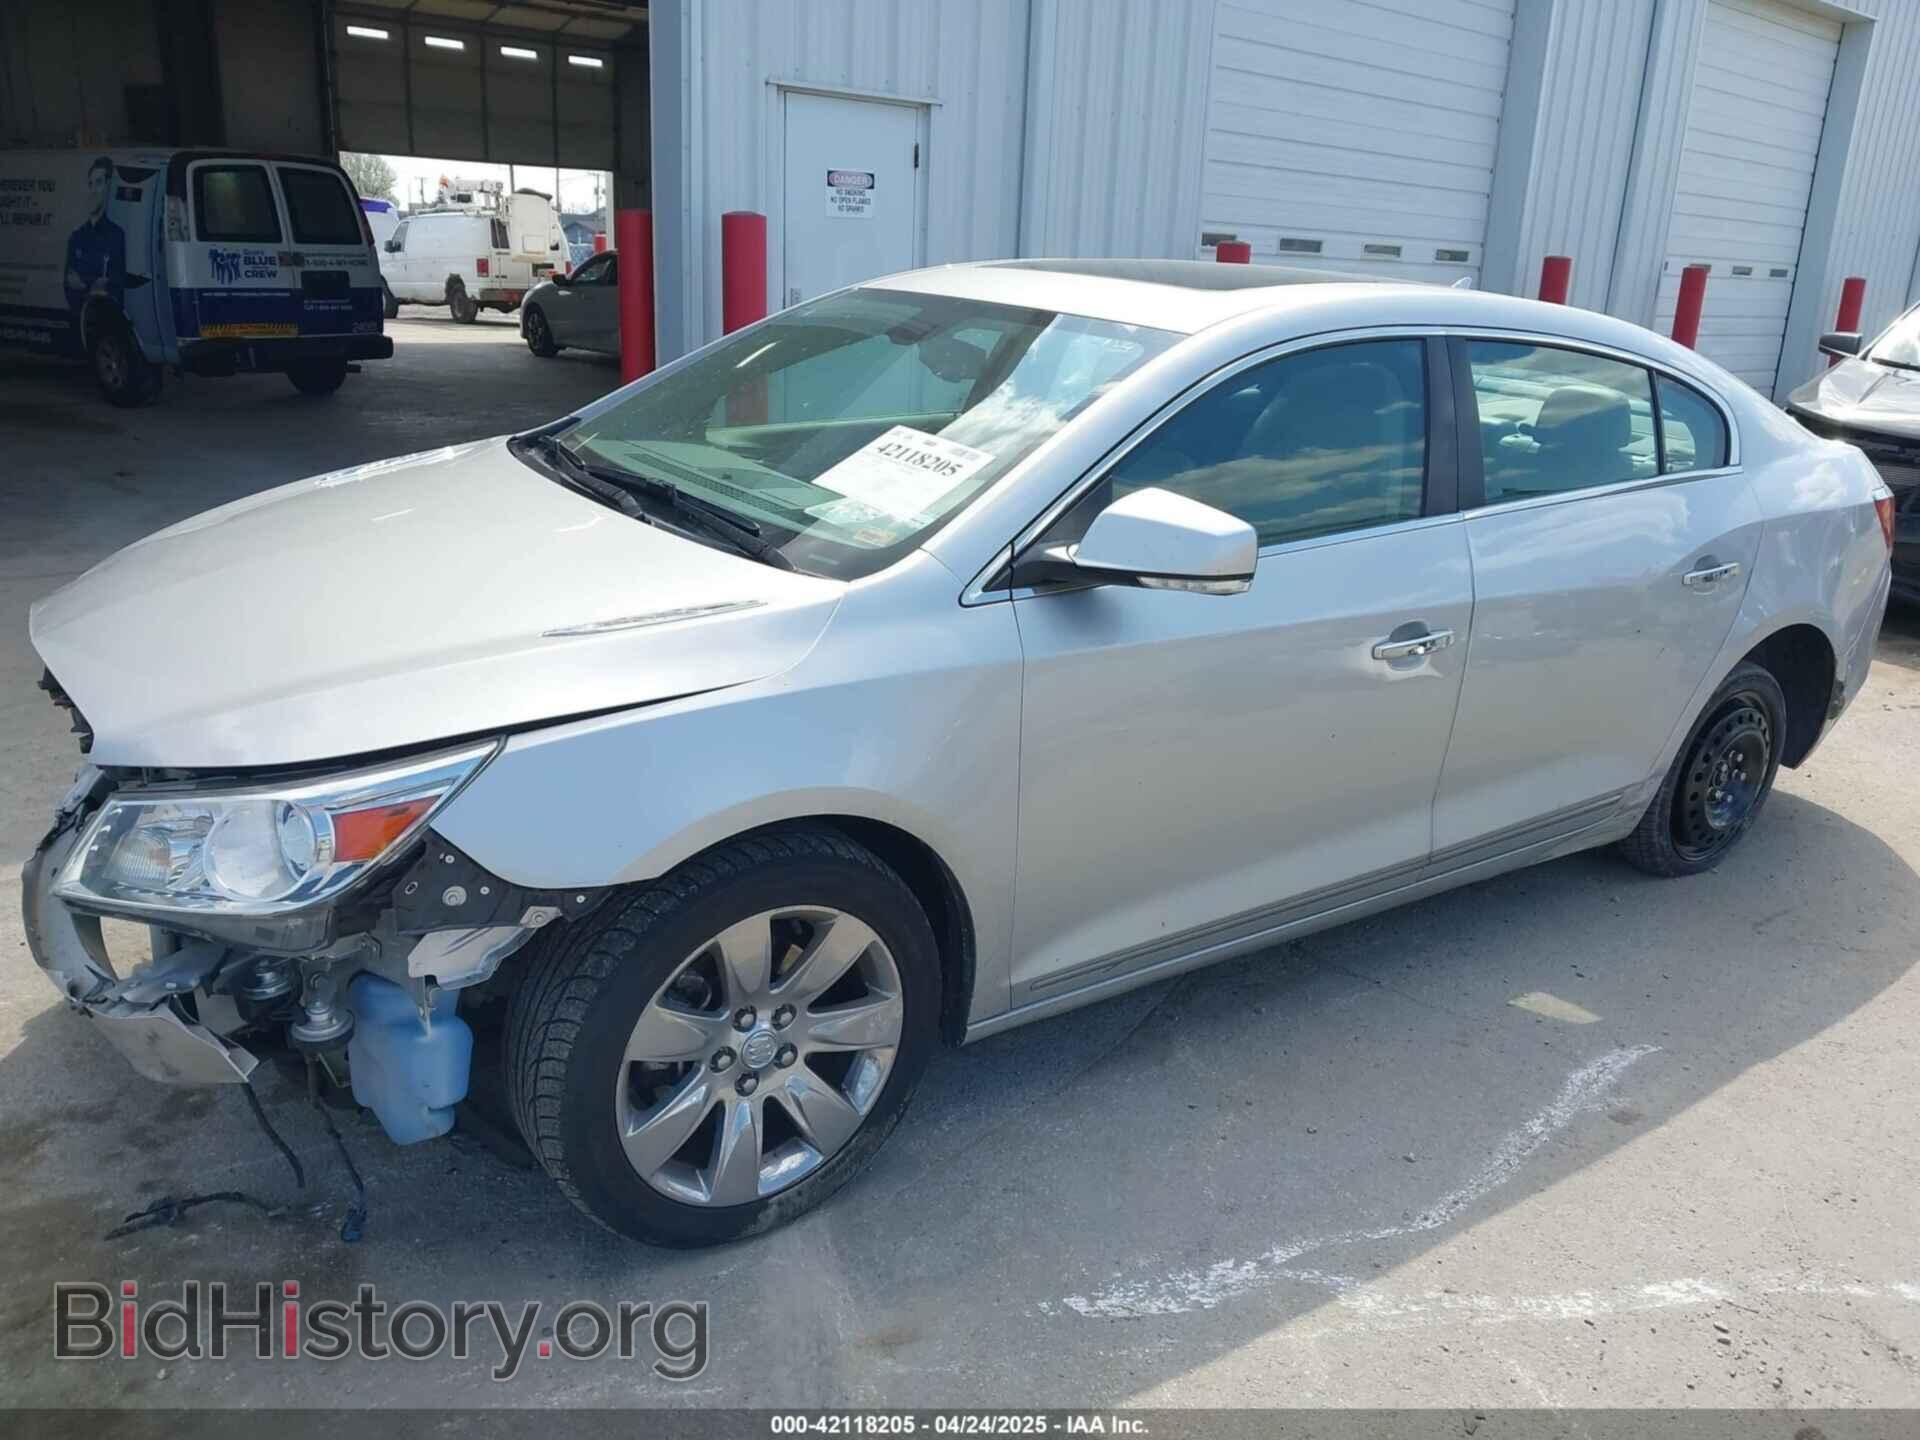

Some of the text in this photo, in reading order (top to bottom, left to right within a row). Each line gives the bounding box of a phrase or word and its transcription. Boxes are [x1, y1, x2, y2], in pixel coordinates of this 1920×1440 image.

[834, 175, 867, 185] DANGER
[243, 255, 277, 266] BLUE
[244, 269, 278, 278] CREW
[877, 442, 963, 476] 42118205
